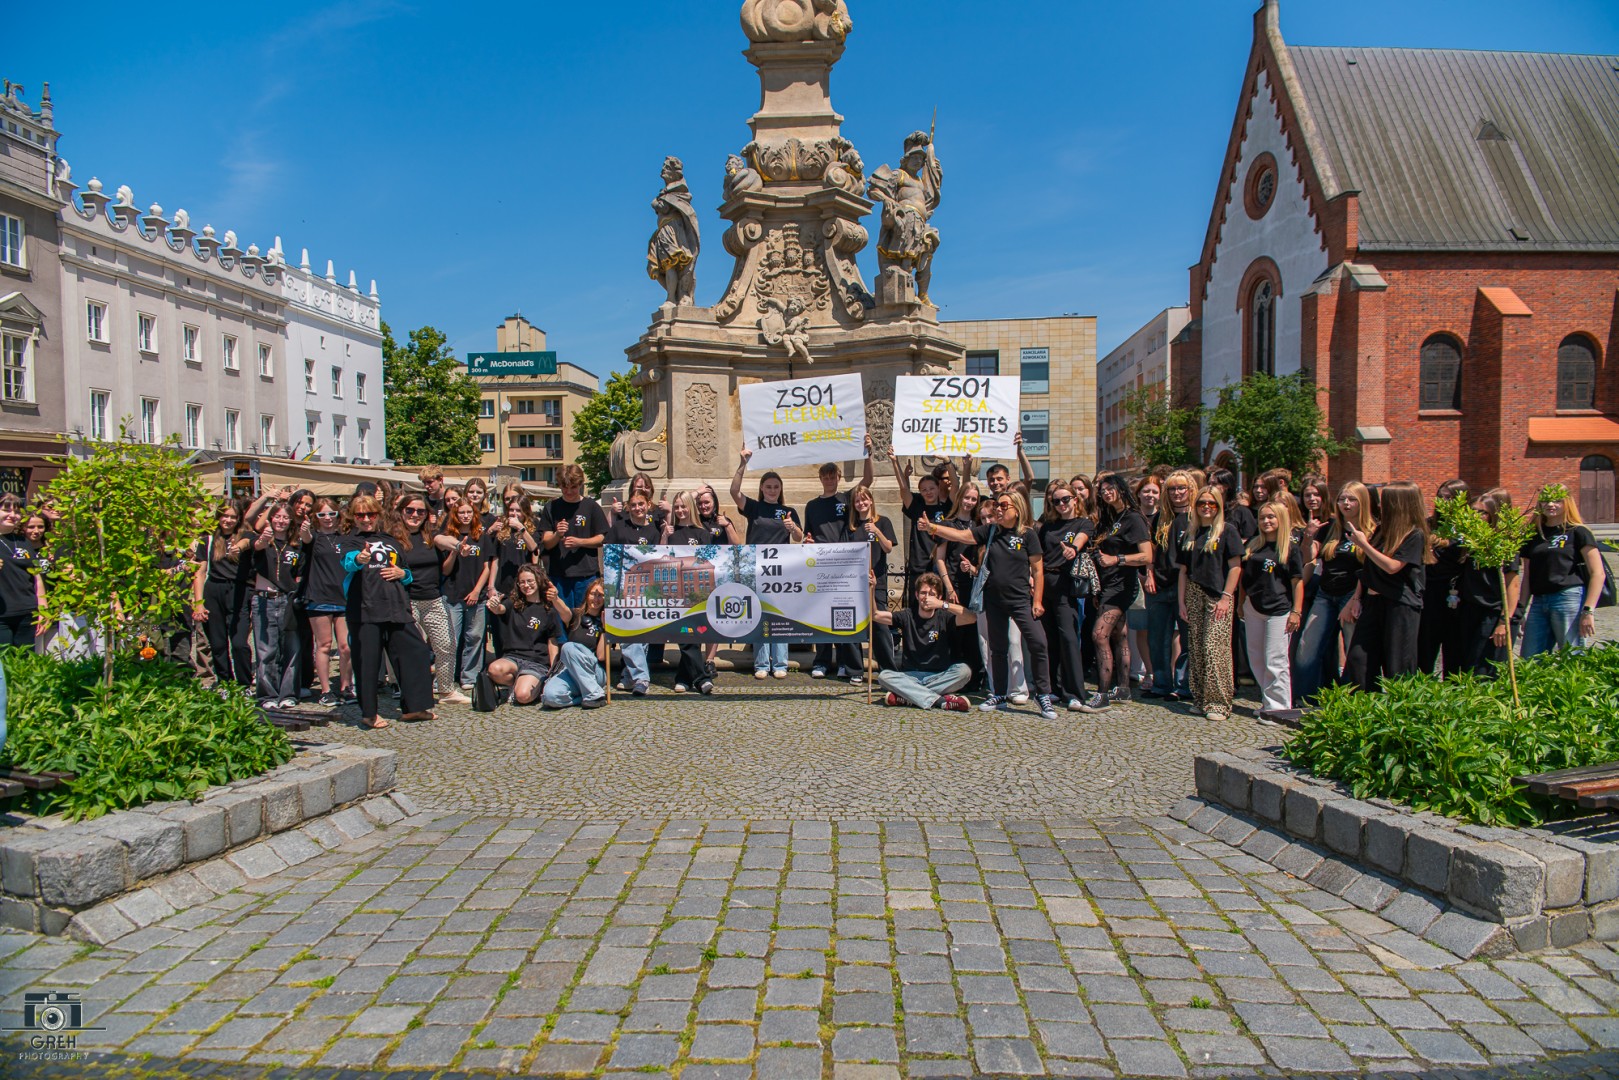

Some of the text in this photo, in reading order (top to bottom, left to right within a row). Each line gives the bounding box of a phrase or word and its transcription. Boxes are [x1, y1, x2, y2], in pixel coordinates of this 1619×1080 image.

[930, 377, 990, 398] ZSO1
[776, 384, 833, 408] ZSO1
[773, 404, 843, 424] LICEUM,
[902, 416, 1008, 433] GDZIE JESTEŚ
[758, 432, 797, 449] KTÓRE
[761, 548, 778, 559] 12
[761, 565, 782, 576] XII
[762, 582, 803, 593] 2025
[608, 596, 685, 608] Jubileusz
[725, 602, 740, 613] 80
[612, 609, 681, 620] 80-lecia
